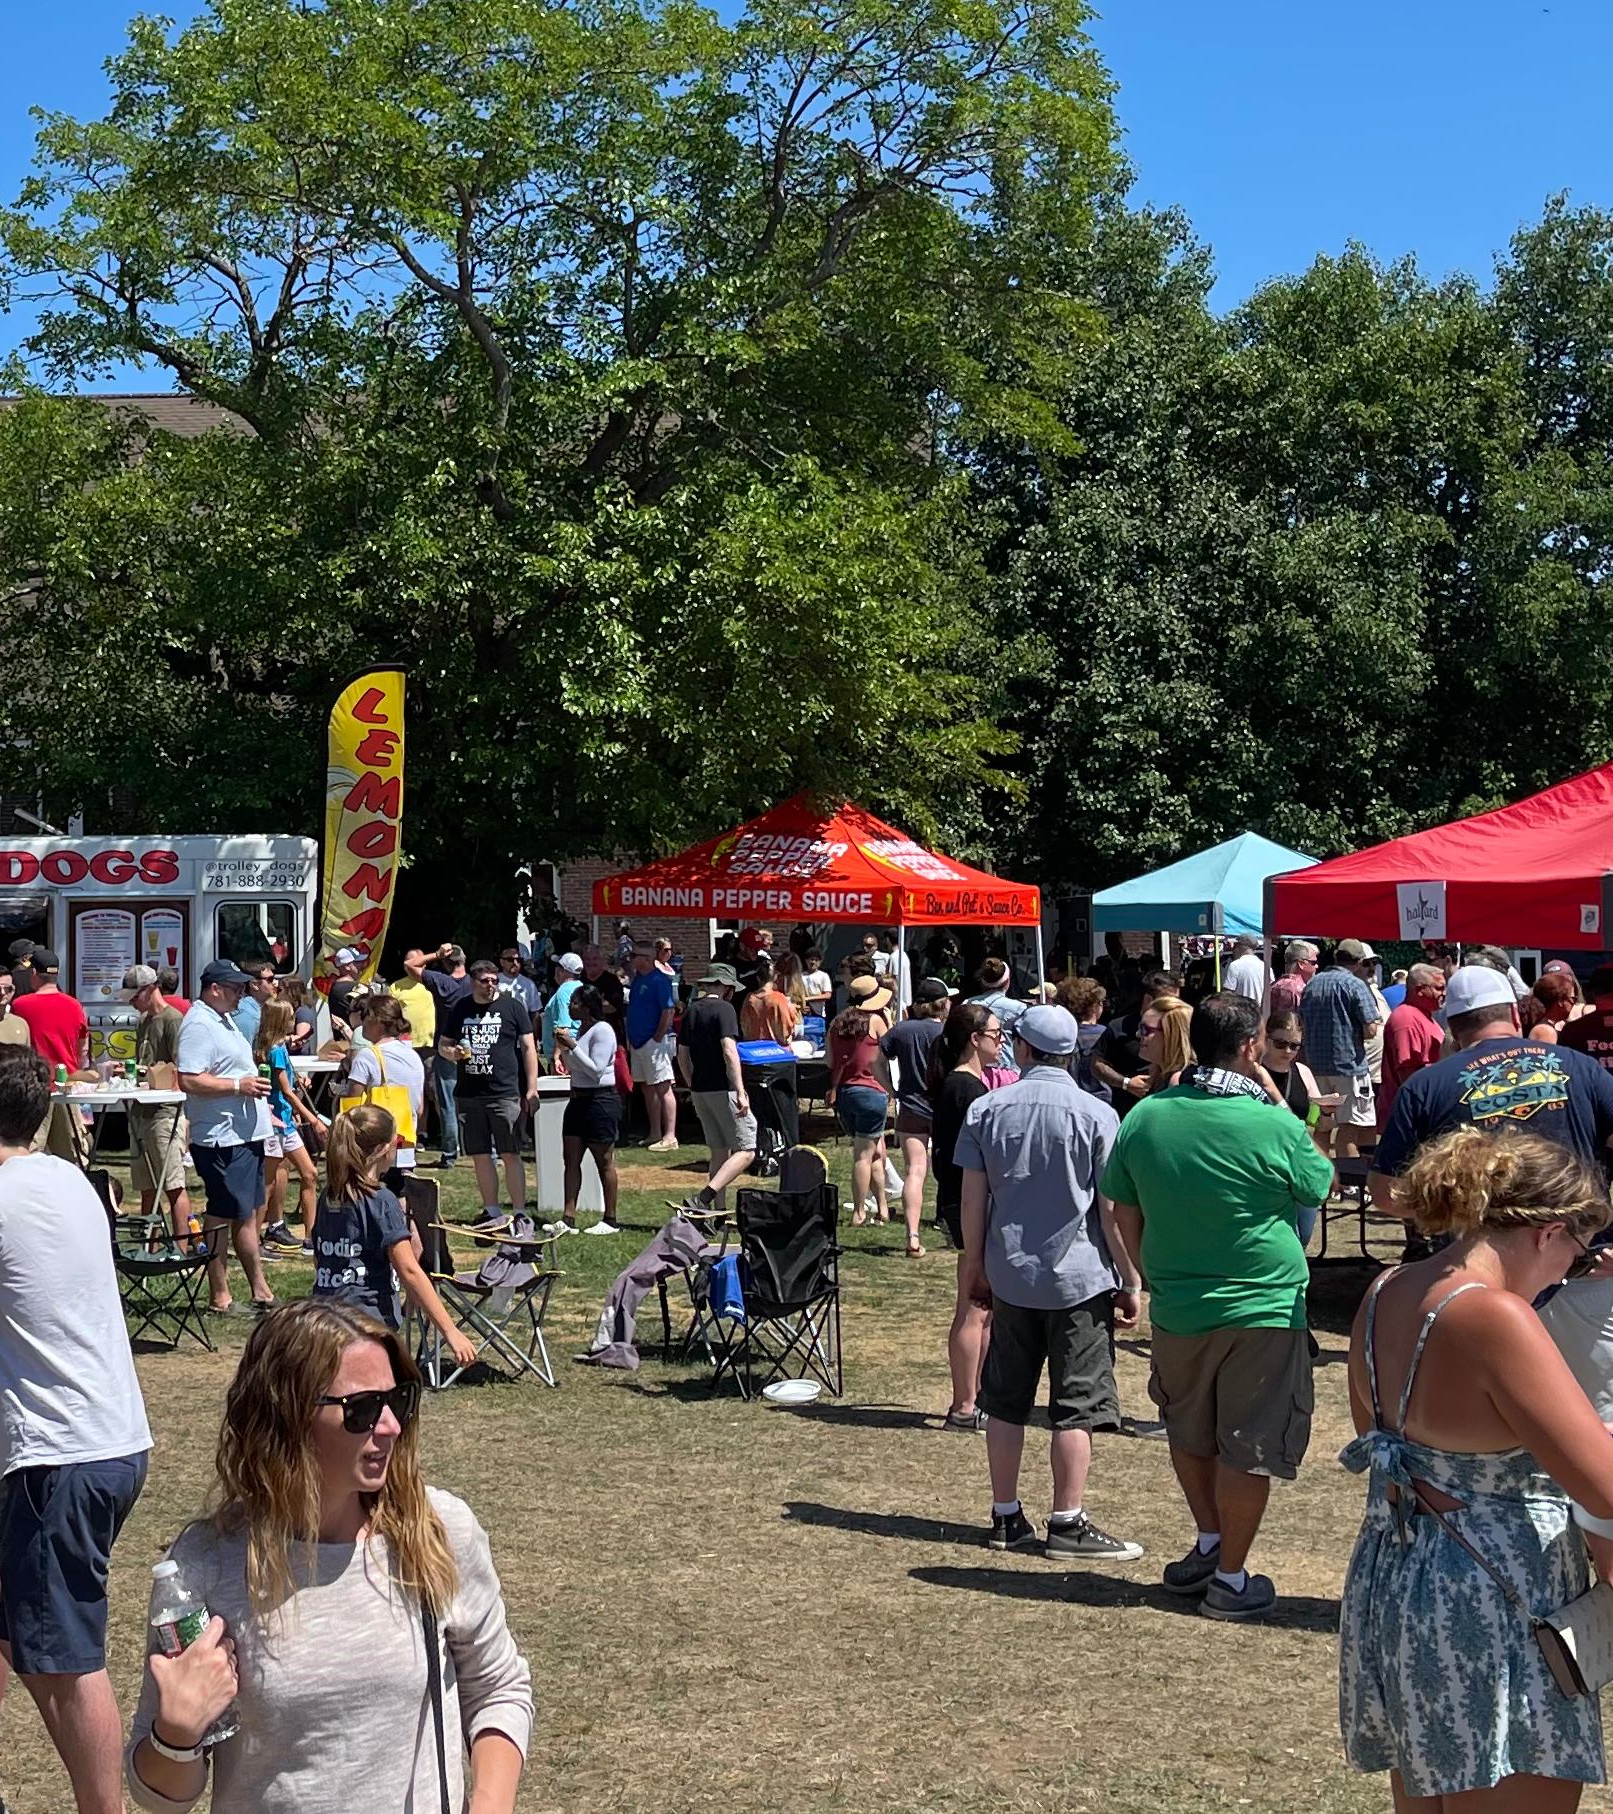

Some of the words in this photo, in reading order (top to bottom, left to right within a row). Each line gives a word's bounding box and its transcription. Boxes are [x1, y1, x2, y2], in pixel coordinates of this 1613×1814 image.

[736, 833, 849, 858] BANANA
[730, 849, 835, 870] PEPPER
[207, 874, 306, 888] 781-888-2930
[620, 886, 705, 908] BANANA
[711, 888, 792, 911] PEPPER
[801, 891, 873, 914] SAUCE
[479, 1024, 502, 1035] JUST
[472, 1034, 499, 1044] SHOW
[468, 1055, 490, 1065] JUST
[465, 1064, 494, 1075] RELAX
[1474, 1084, 1565, 1113] COSTA
